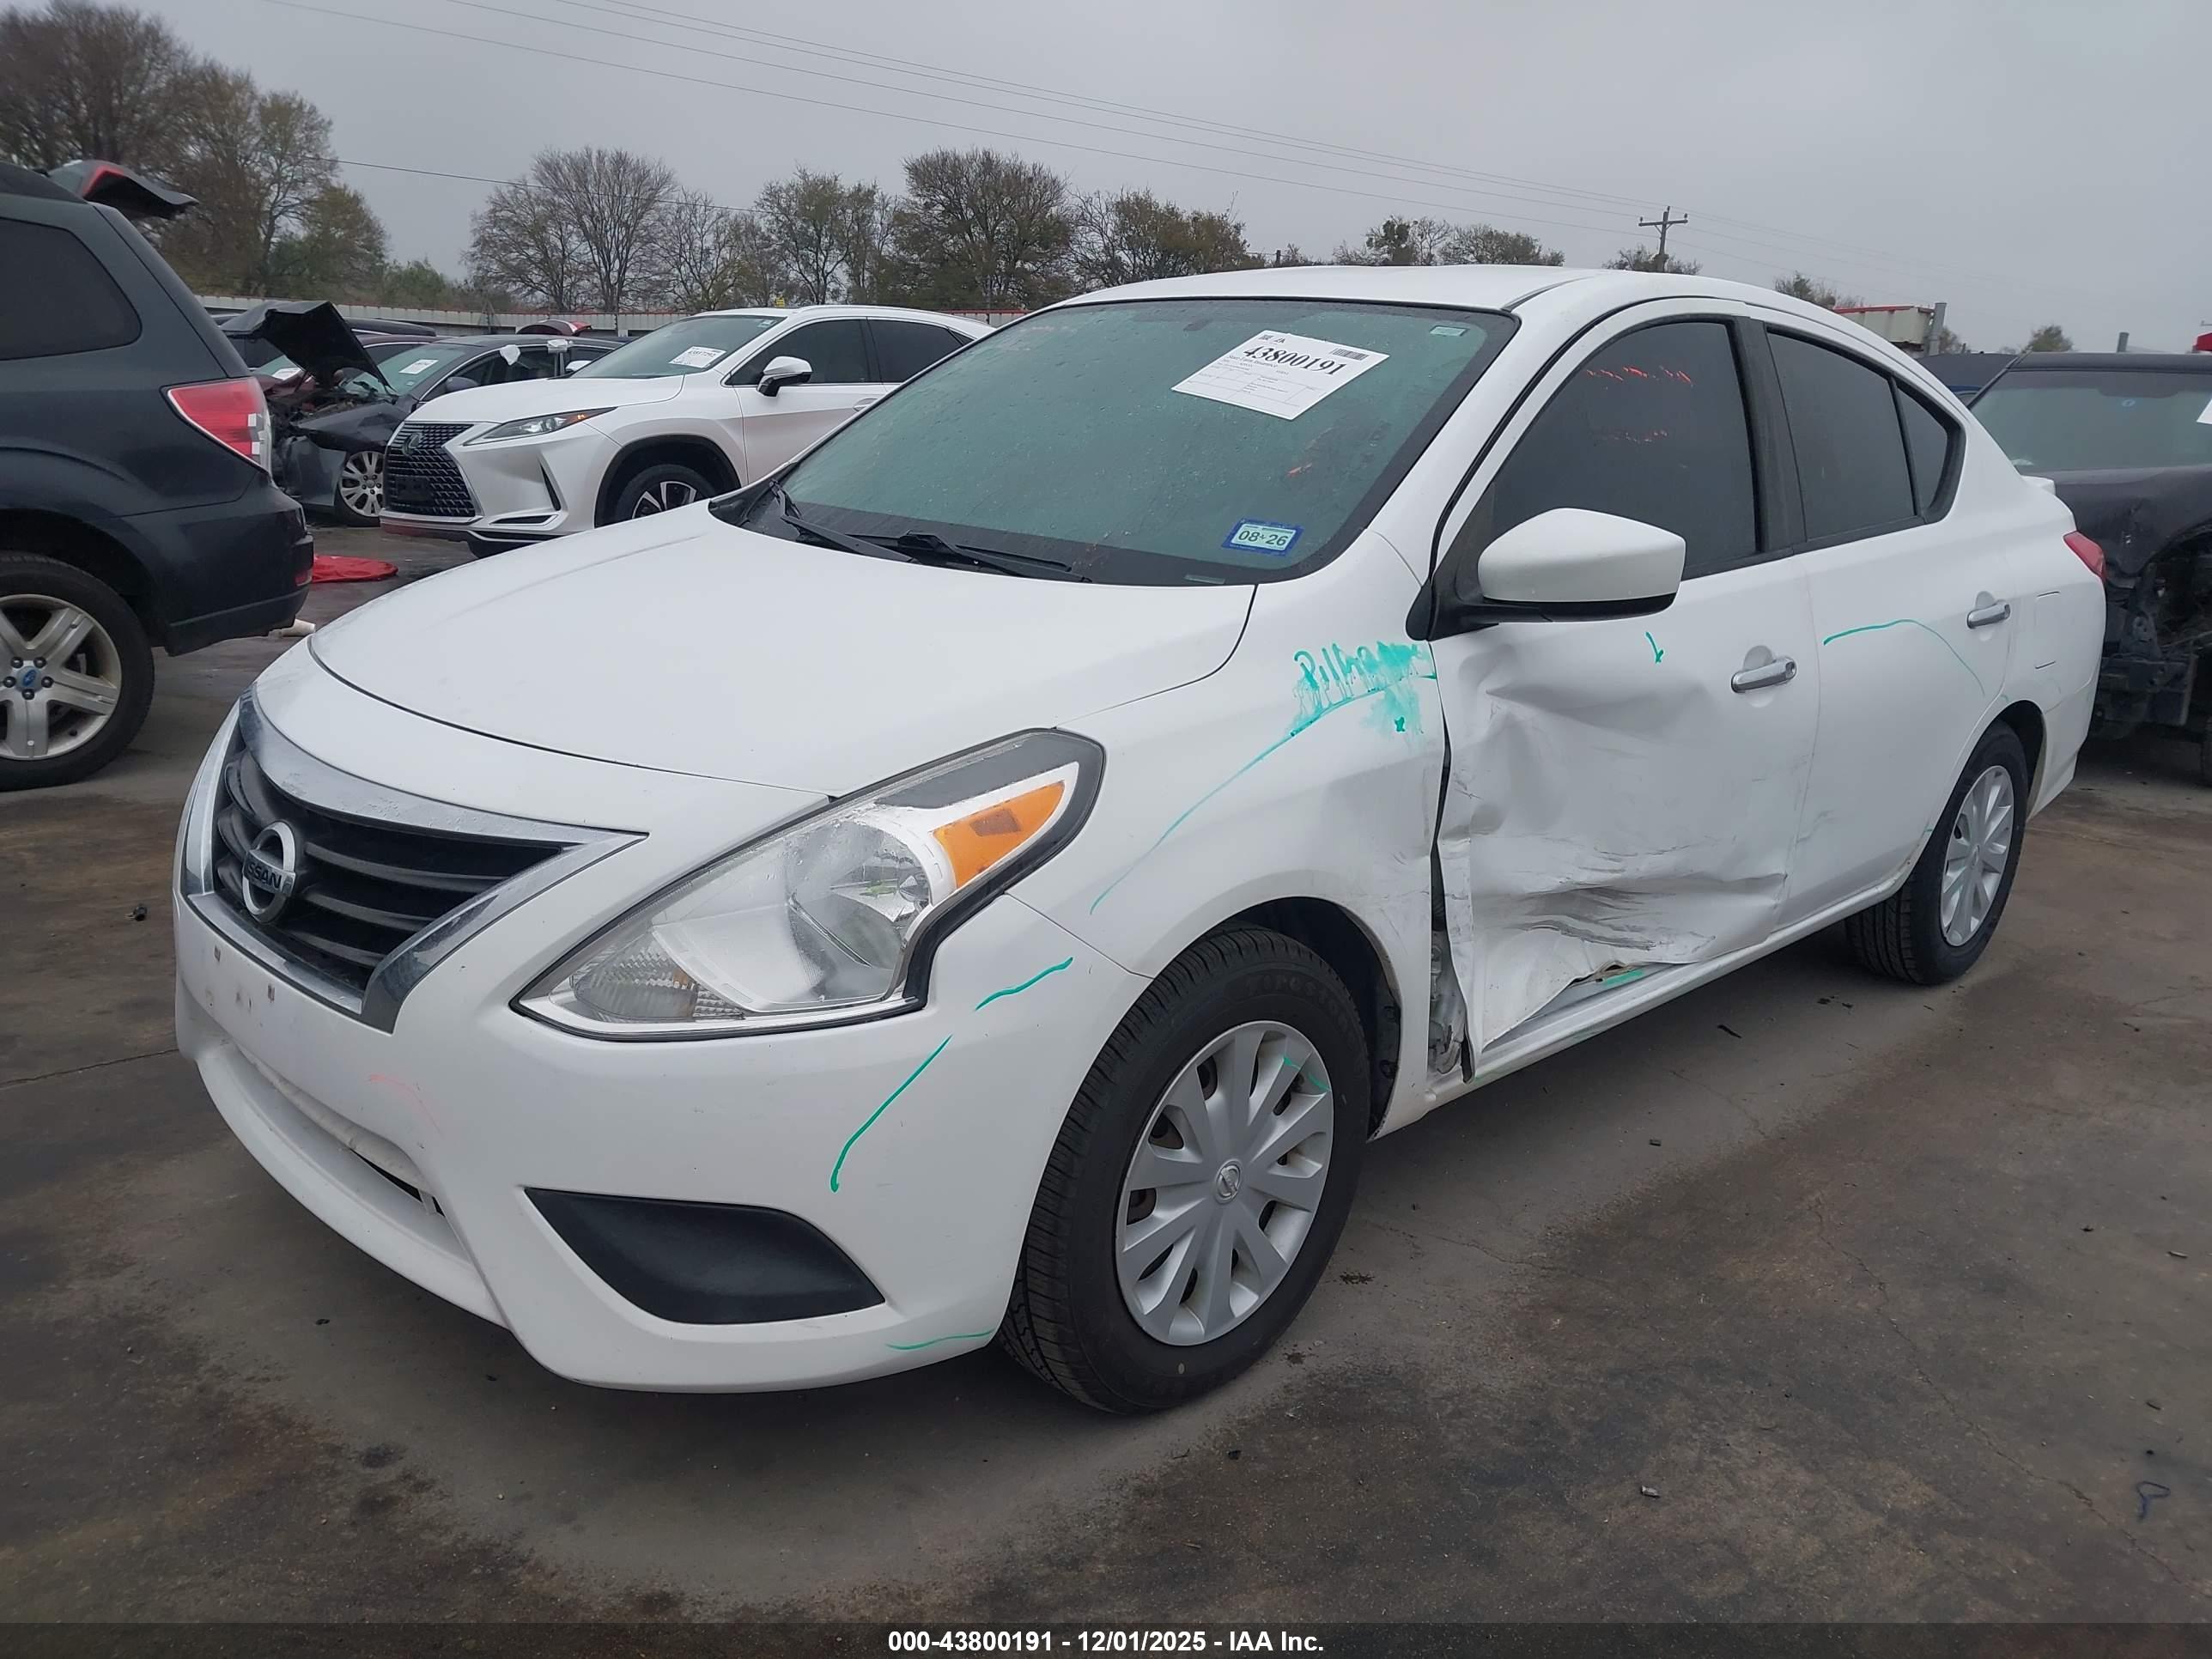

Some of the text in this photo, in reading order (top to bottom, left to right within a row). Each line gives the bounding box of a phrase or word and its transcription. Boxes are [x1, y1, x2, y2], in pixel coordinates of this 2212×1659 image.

[1243, 345, 1347, 375] 43800191
[1238, 530, 1289, 546] 08 26
[245, 861, 283, 890] SSAN
